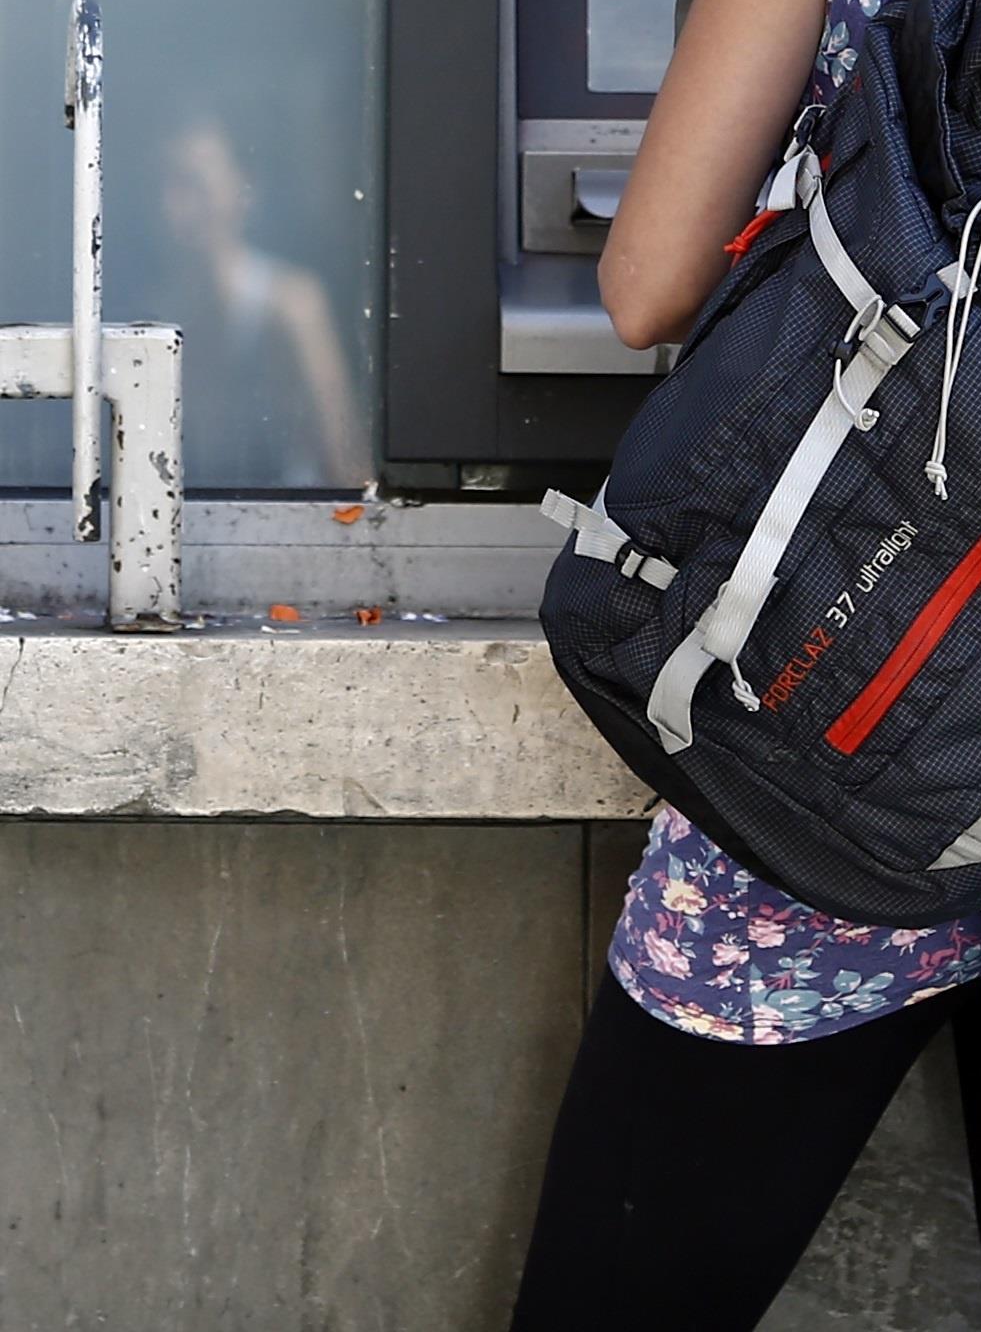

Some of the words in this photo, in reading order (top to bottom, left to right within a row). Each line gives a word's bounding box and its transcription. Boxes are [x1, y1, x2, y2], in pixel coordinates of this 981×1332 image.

[762, 625, 836, 713] FORCLAZ
[825, 590, 856, 629] 37
[856, 520, 919, 593] ultralight
